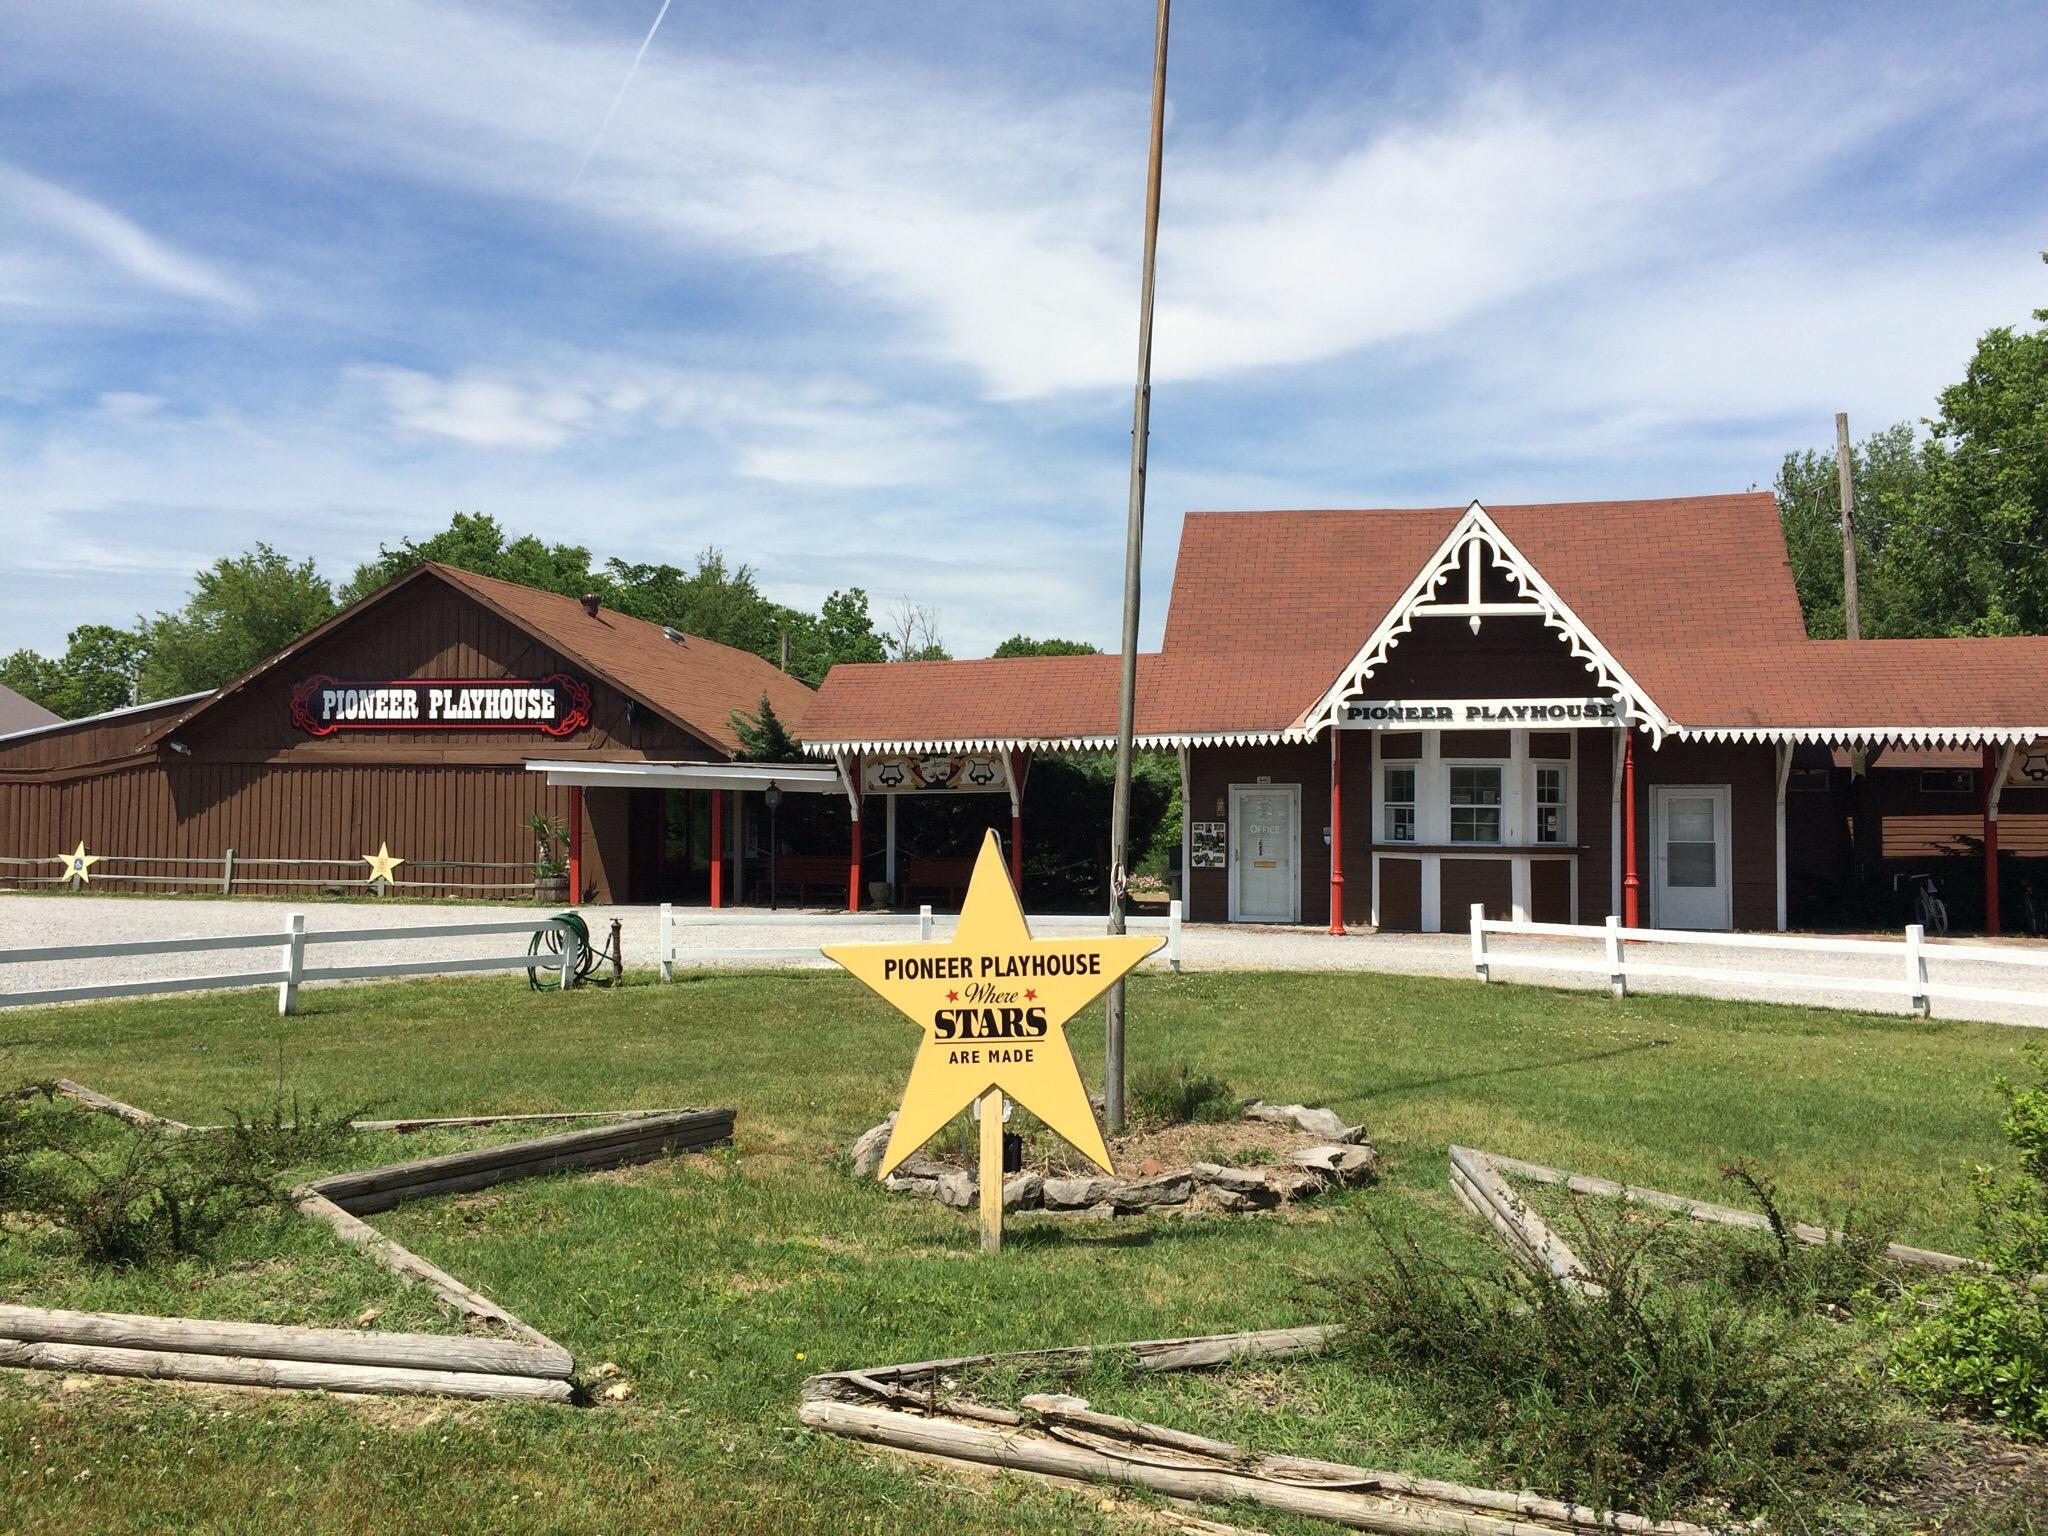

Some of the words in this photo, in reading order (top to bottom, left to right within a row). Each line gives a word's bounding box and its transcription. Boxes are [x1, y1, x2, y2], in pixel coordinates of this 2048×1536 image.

[322, 689, 419, 720] PIONEER
[429, 688, 555, 719] PLAYHOUSE
[1348, 706, 1453, 722] PIONEER
[1466, 704, 1616, 721] PLAYHOUSE
[1250, 824, 1281, 834] OFFICE
[884, 957, 973, 980] PIONEER
[981, 953, 1101, 977] PLAYHOUSE
[964, 982, 1019, 1004] Where
[934, 1007, 1048, 1040] STARS
[949, 1050, 980, 1064] ARE
[988, 1049, 1034, 1063] MADE
